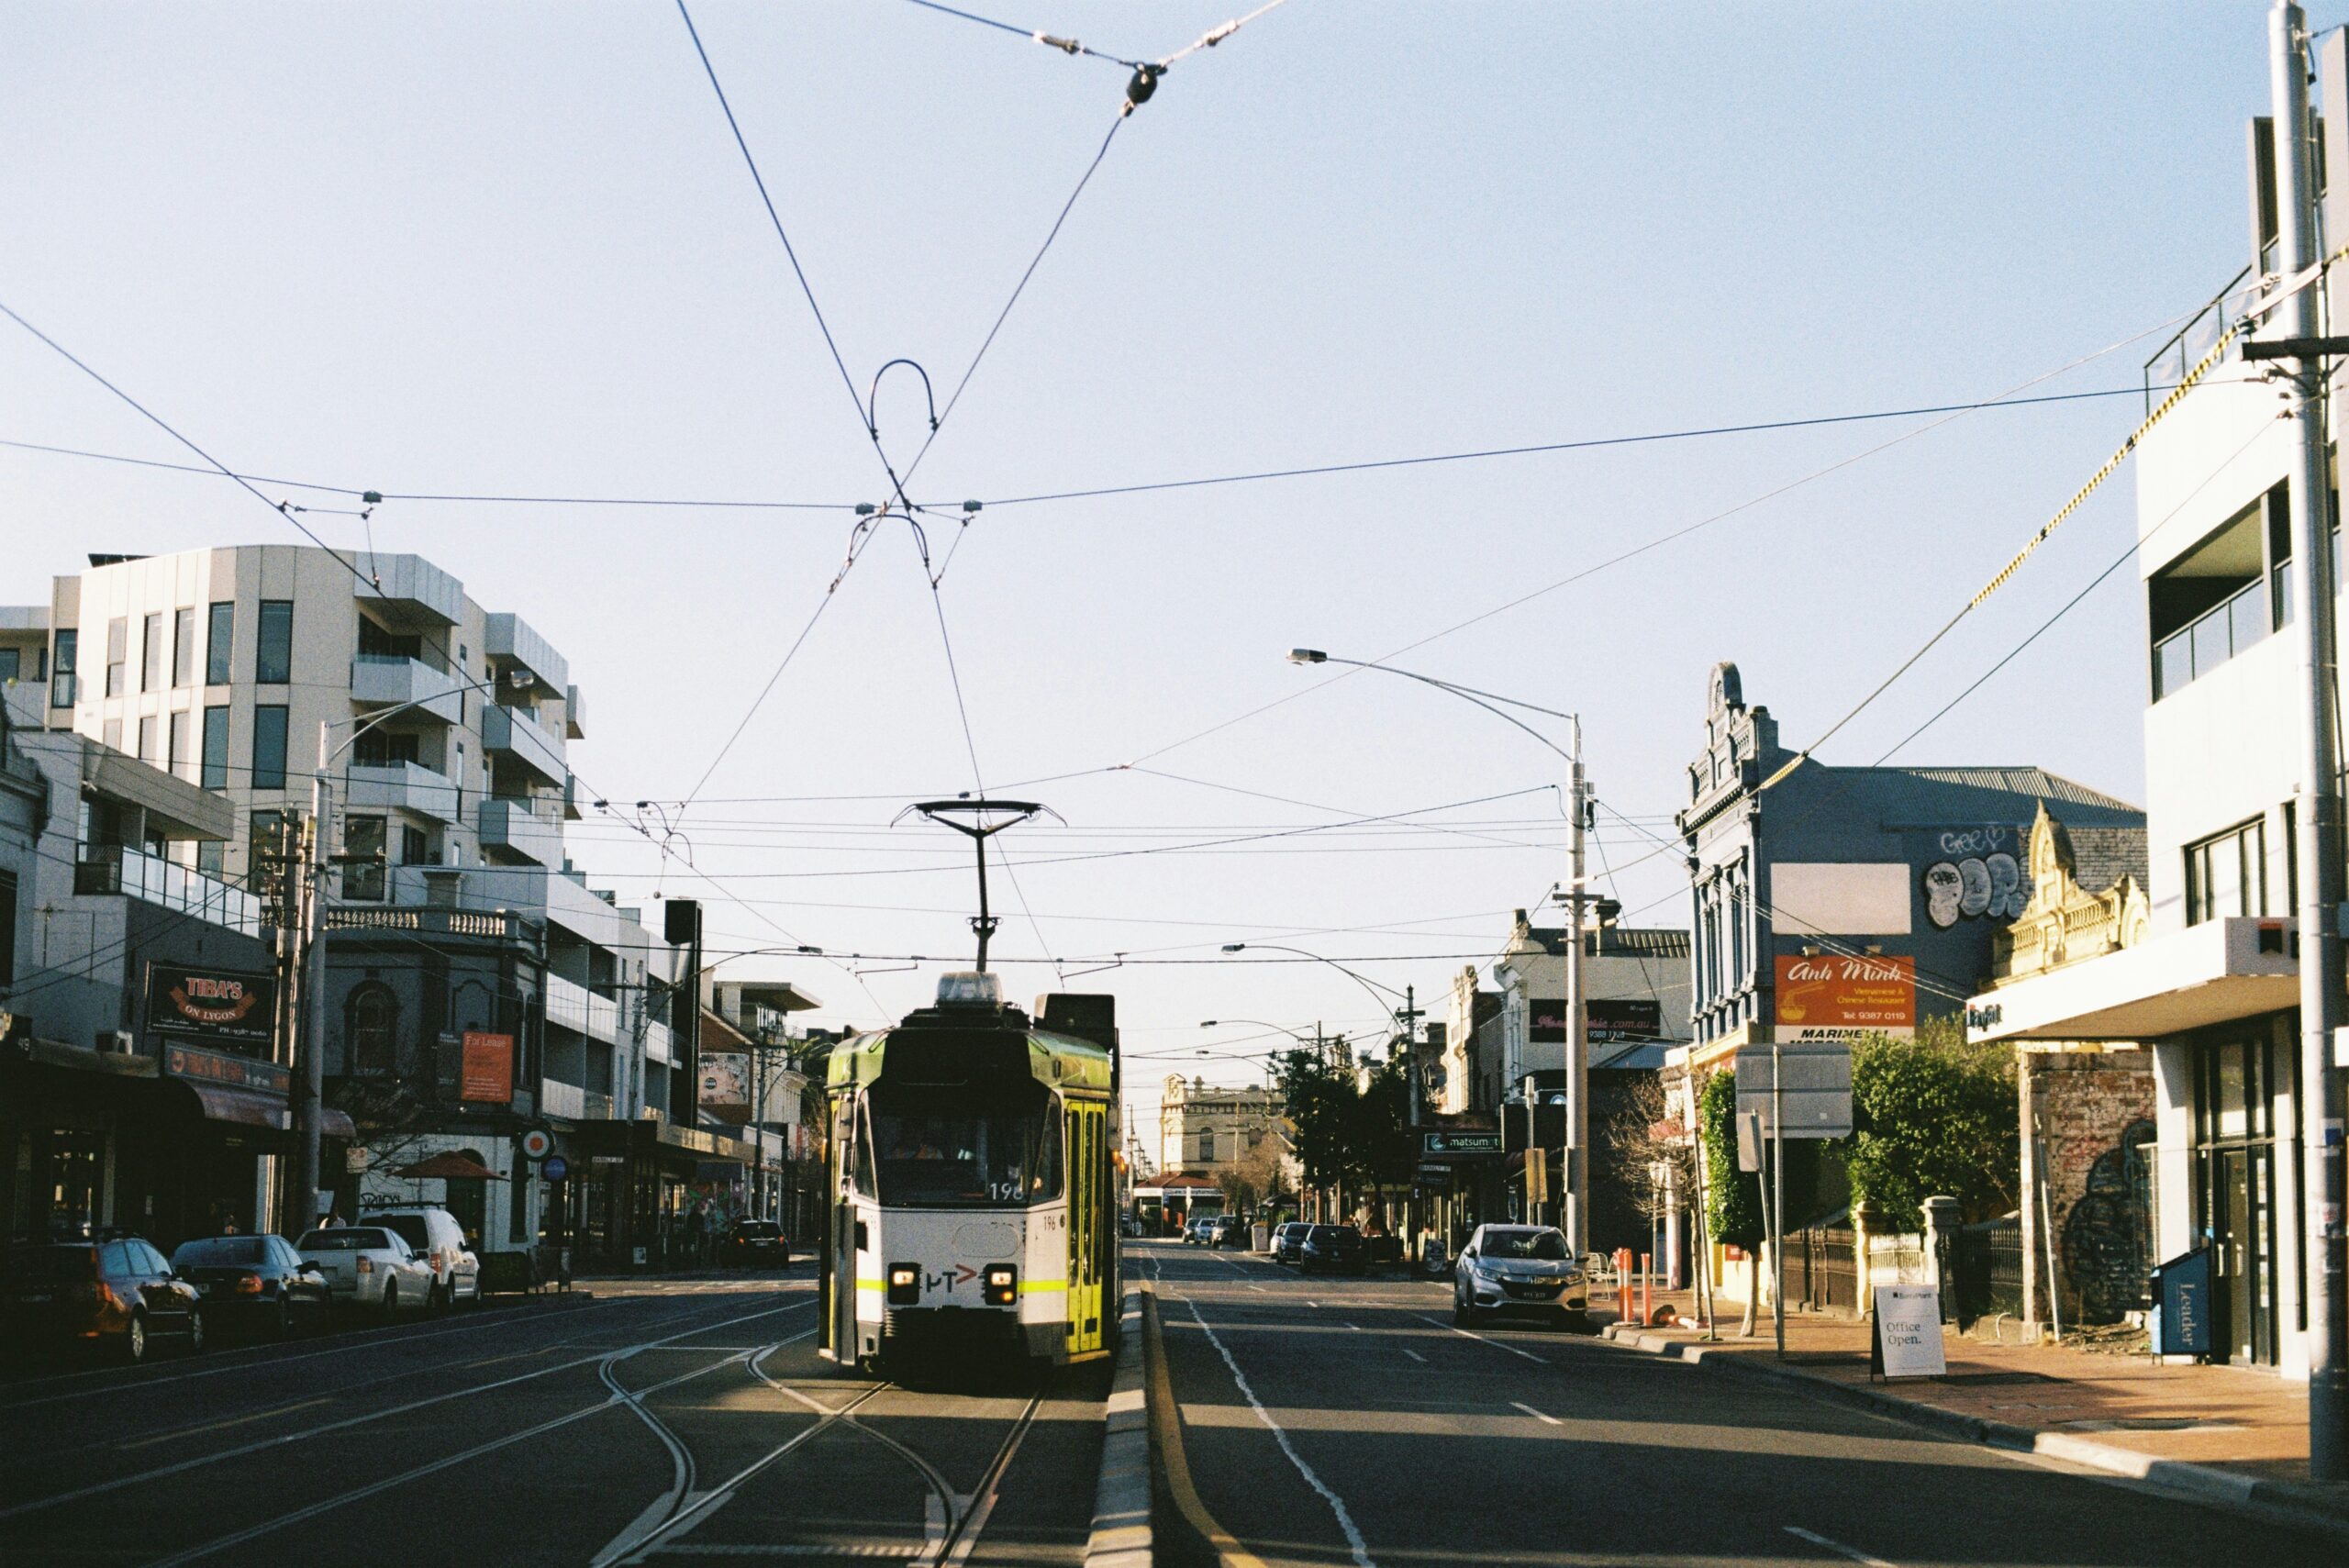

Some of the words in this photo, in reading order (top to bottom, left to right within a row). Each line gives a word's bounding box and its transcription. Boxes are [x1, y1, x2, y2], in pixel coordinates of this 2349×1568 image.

[1787, 962, 1833, 981] Anh
[1840, 960, 1902, 981] Minh
[185, 977, 243, 999] TIBA'S
[1837, 995, 1865, 1004] Chinese
[185, 1005, 200, 1017] ON
[203, 1010, 236, 1020] LYGON
[1858, 1012, 1882, 1020] 9387
[1884, 1012, 1906, 1020] 0119
[466, 1036, 480, 1046] For
[483, 1037, 506, 1048] Lease
[990, 1183, 1023, 1200] 196
[1044, 1216, 1056, 1230] 196
[2179, 1284, 2197, 1346] Leader
[1887, 1322, 1920, 1333] Office
[1888, 1335, 1922, 1347] Open.
